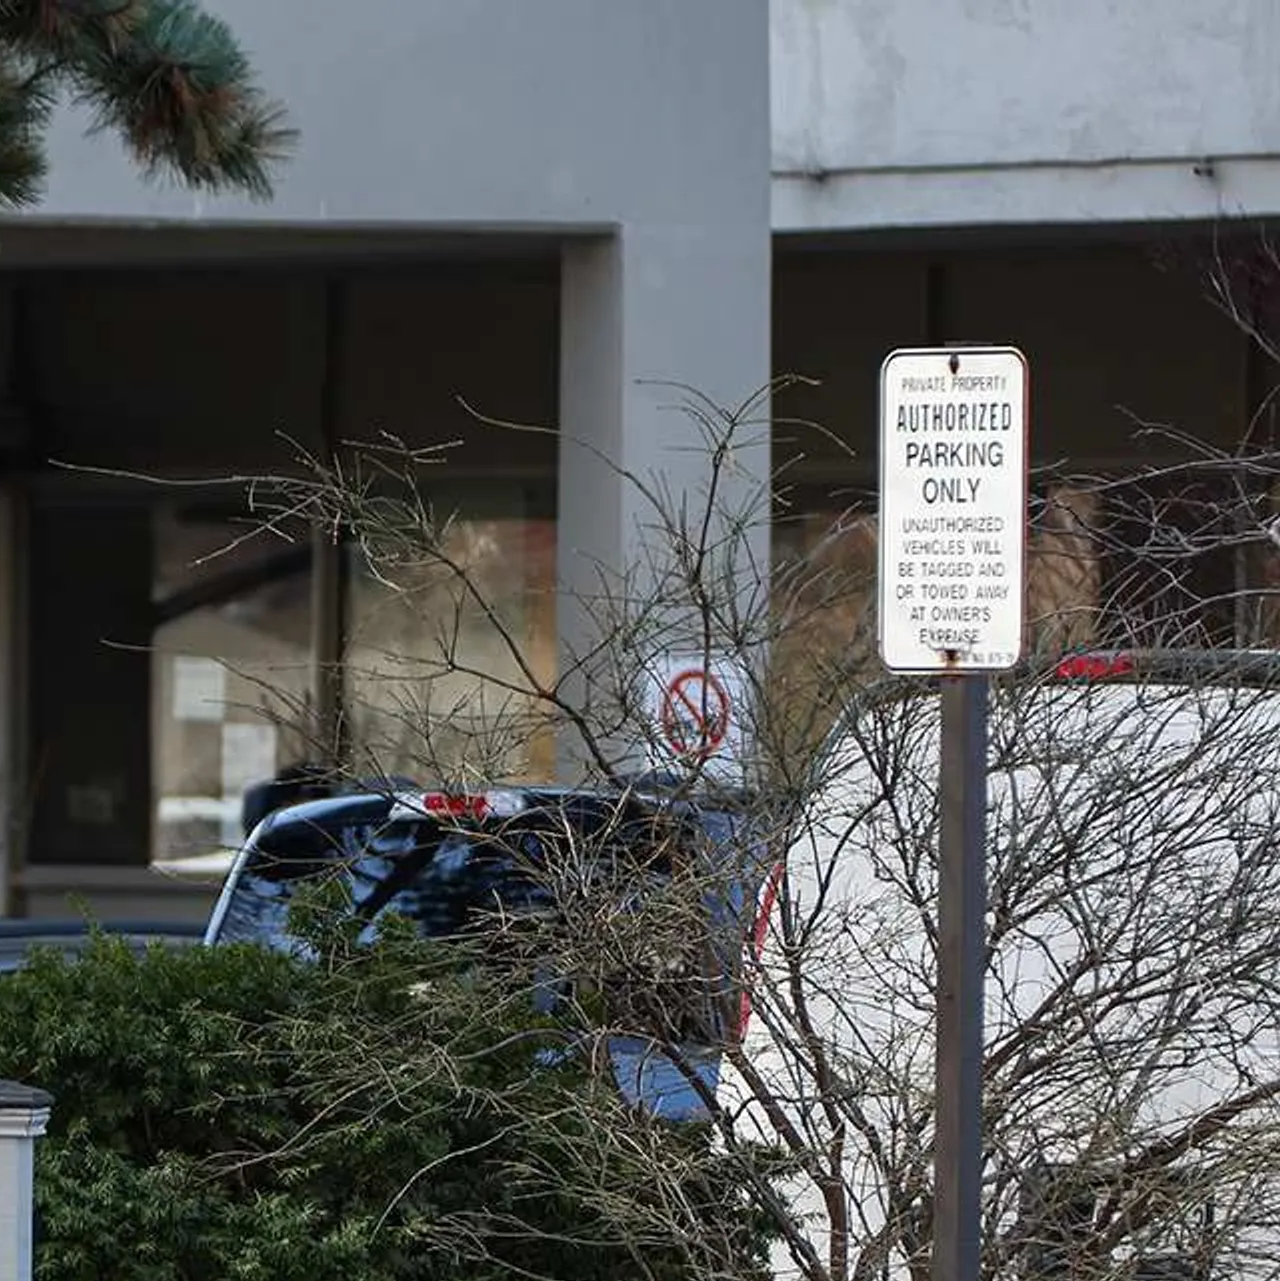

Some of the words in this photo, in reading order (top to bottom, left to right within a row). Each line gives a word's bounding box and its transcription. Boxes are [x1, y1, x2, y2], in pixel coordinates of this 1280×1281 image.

[901, 375, 947, 393] PRIVATE
[951, 375, 1008, 392] PROPERTY
[896, 402, 1012, 433] AUTHORIZED
[905, 440, 1004, 468] PARKING
[922, 477, 981, 504] ONLY
[902, 516, 1005, 534] UNAUTHORIZED
[902, 539, 966, 556] VEHICLES
[972, 540, 1003, 556] WILL
[897, 561, 915, 578] BE
[921, 561, 974, 578] TAGGED
[978, 561, 1006, 578] AND
[896, 584, 914, 600] OR
[920, 583, 969, 600] TOWED
[975, 584, 1010, 600] AWAY
[910, 606, 926, 621] AT
[919, 628, 981, 645] EXPENSE
